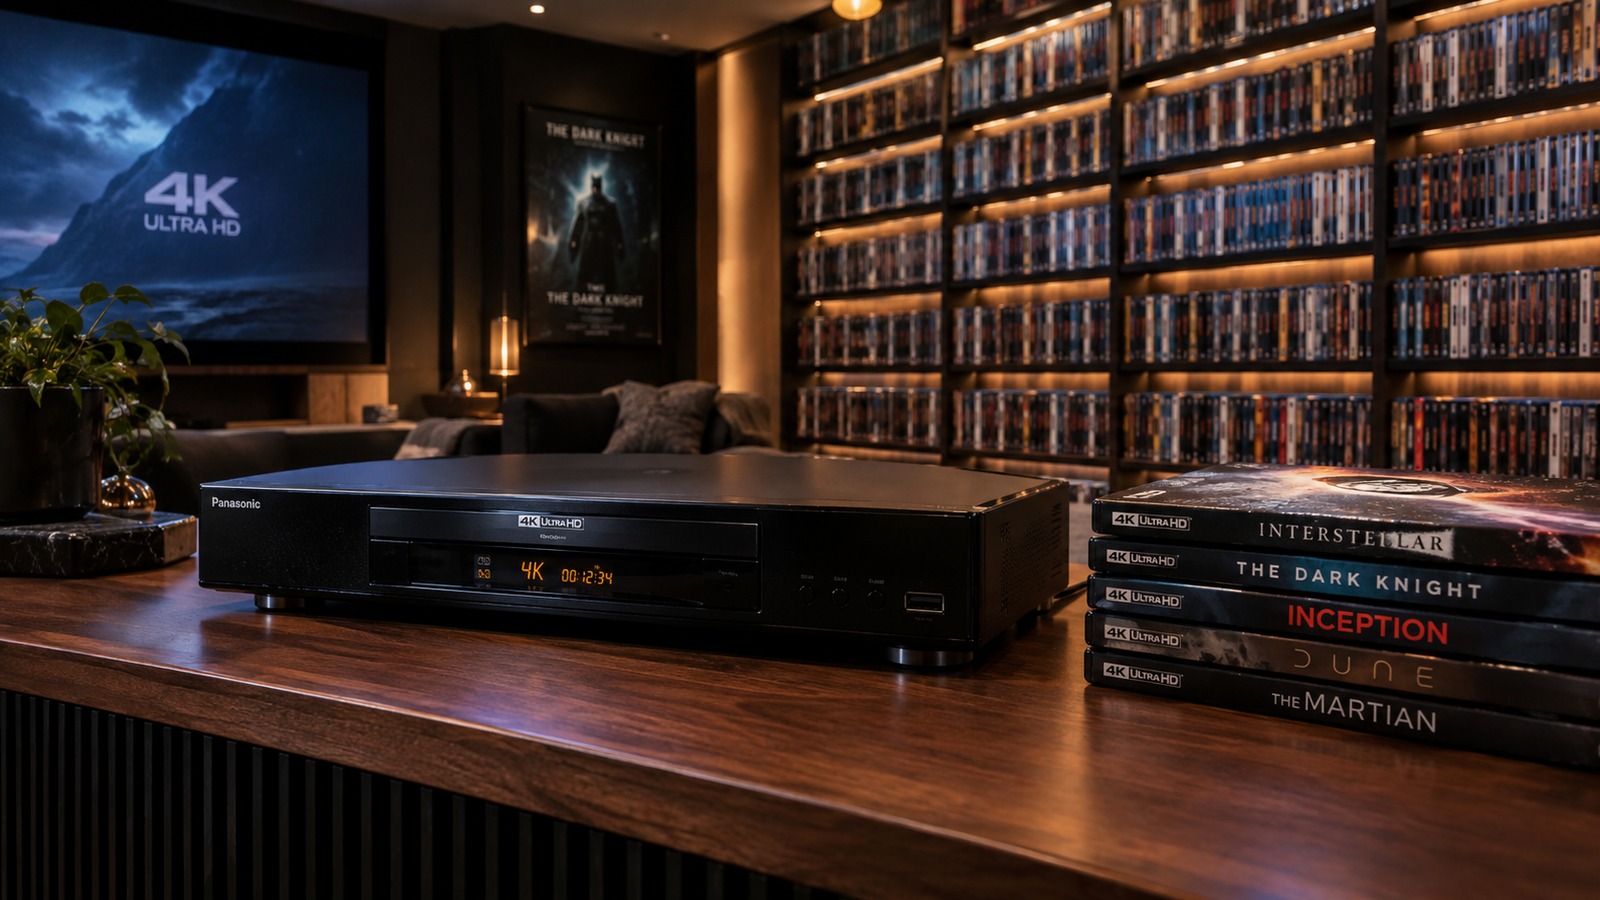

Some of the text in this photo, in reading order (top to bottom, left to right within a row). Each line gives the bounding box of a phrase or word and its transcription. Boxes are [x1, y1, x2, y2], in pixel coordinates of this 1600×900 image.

[546, 121, 569, 139] THE
[571, 125, 603, 142] DARK
[605, 130, 645, 149] KNIGHT
[144, 171, 239, 219] 4K
[144, 213, 241, 237] ULTRA HD
[546, 291, 644, 308] THE DARK KNIGHT
[211, 496, 261, 509] Panasonic
[519, 516, 538, 527] 4K
[1114, 513, 1136, 526] 4K
[1258, 522, 1444, 552] INTERSTELLAR
[1107, 551, 1128, 563] 4K
[521, 561, 613, 585] 4K 00:12:34
[1236, 561, 1482, 600] THE DARK KNIGHT
[1107, 589, 1129, 601] 4K
[1106, 627, 1127, 639] 4K
[1288, 604, 1448, 645] INCEPTION
[1105, 665, 1126, 678] 4K
[1293, 648, 1434, 689] DUNE
[1271, 691, 1437, 733] THE MARTIAN
